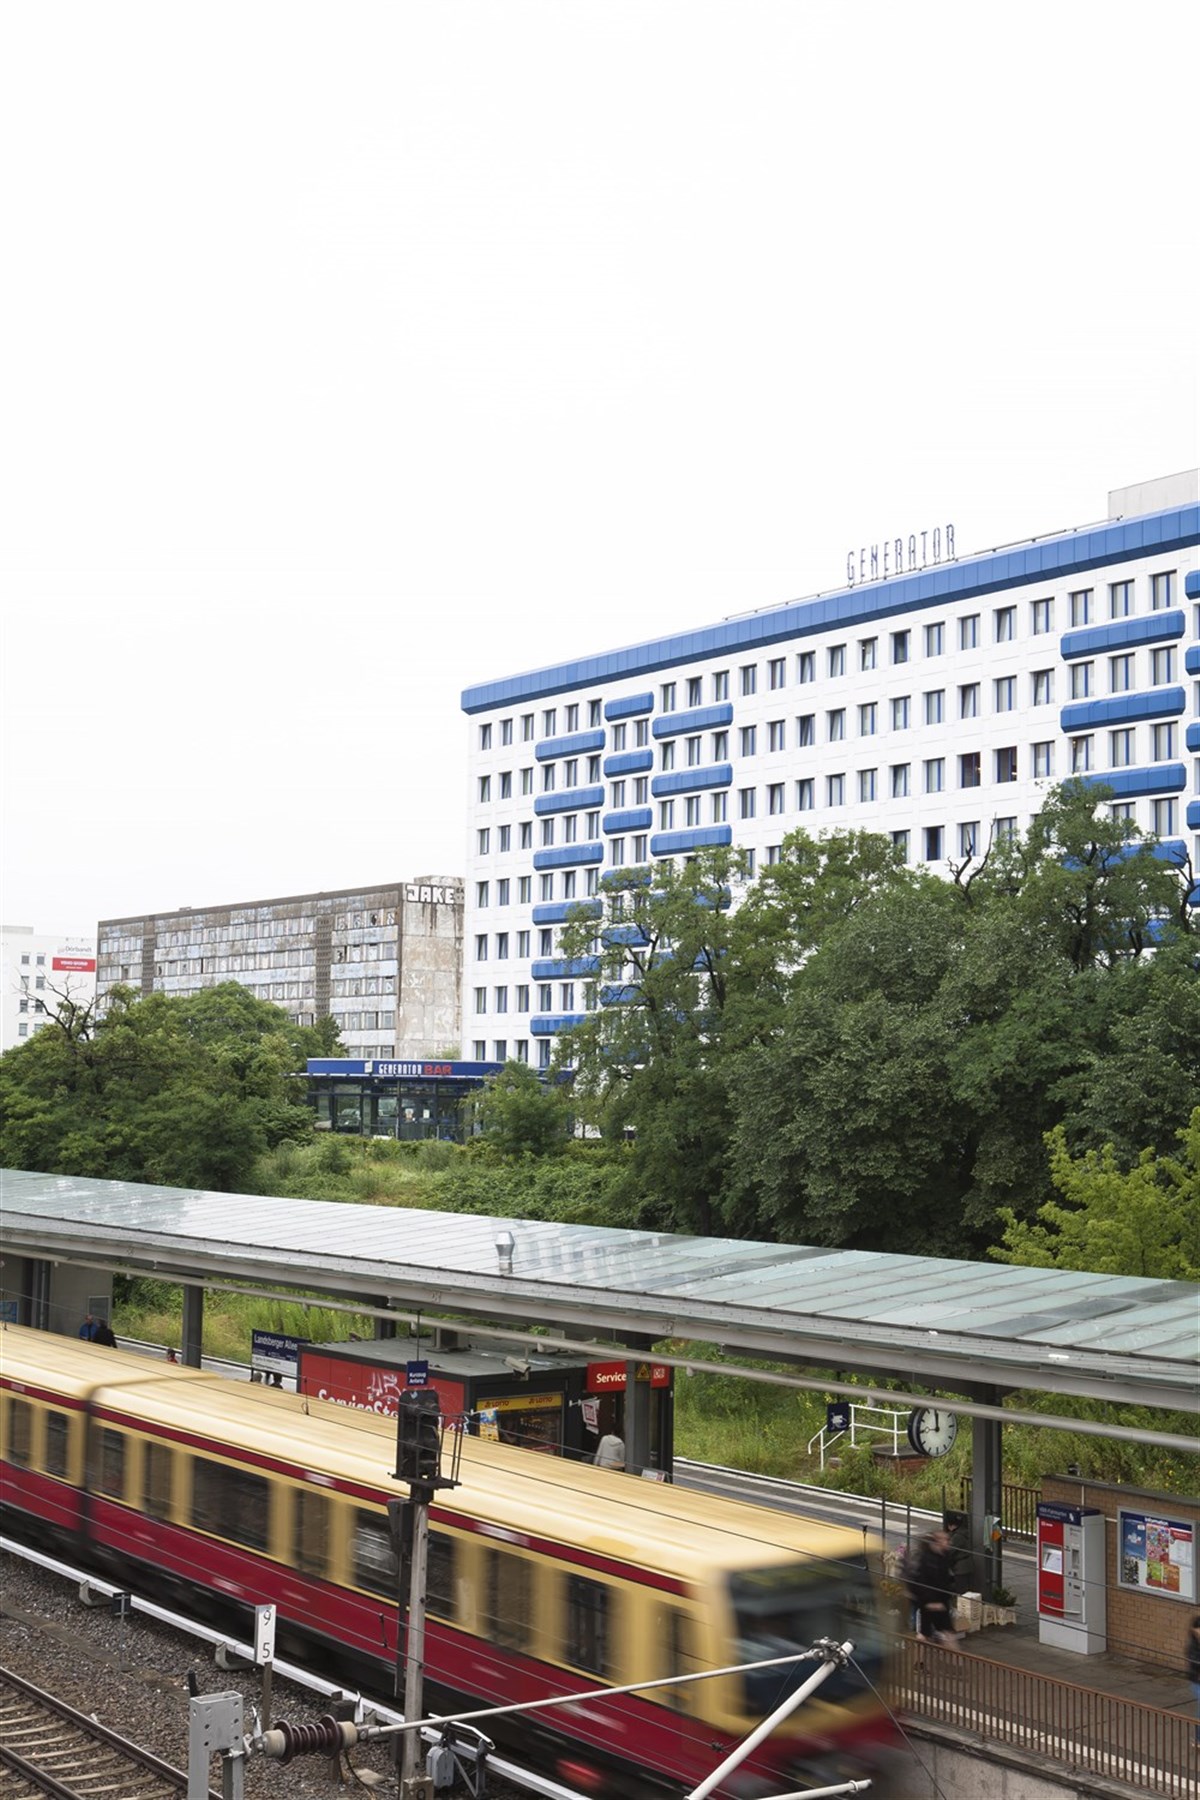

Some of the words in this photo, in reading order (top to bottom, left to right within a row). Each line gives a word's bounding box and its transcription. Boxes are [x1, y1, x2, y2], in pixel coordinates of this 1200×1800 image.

[847, 523, 955, 581] GENERATOR
[405, 884, 455, 905] JAKE
[379, 1063, 422, 1075] GENERATOR
[424, 1064, 452, 1075] BAR
[254, 1333, 285, 1350] Landsberger
[596, 1371, 627, 1384] Service
[263, 1609, 271, 1626] 9
[262, 1642, 270, 1659] 5
